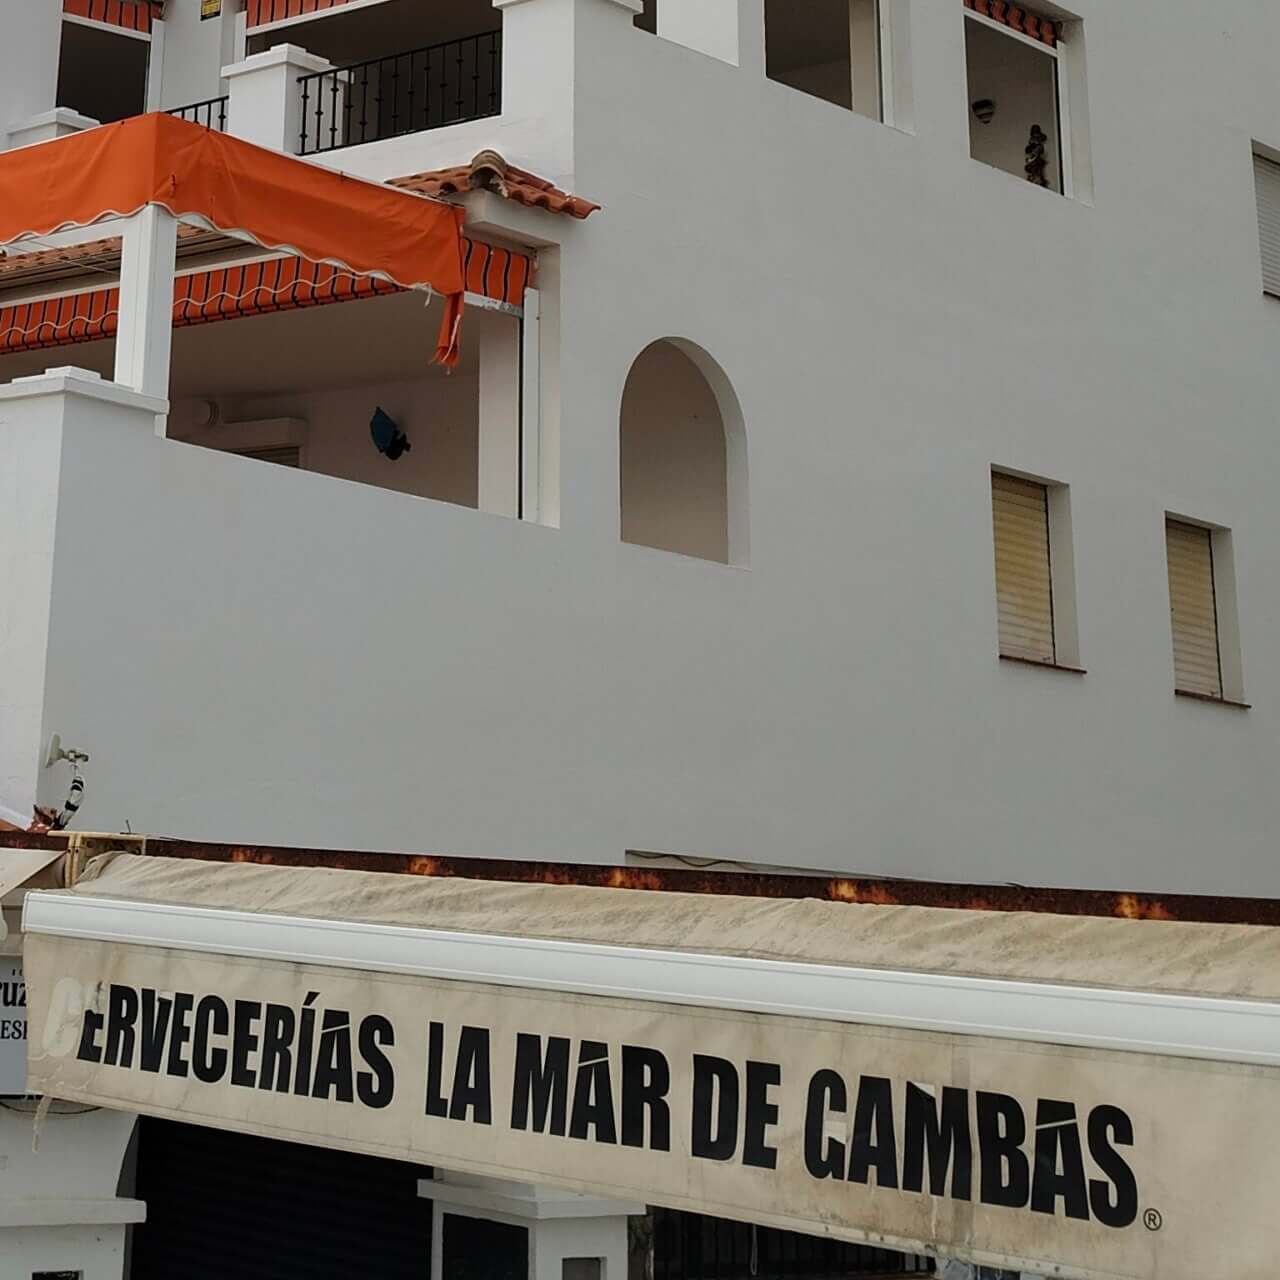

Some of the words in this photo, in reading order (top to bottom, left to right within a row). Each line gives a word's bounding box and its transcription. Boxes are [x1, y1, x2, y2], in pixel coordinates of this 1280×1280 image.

[426, 1021, 492, 1126] LA
[691, 1053, 781, 1170] DE
[804, 1068, 1138, 1229] GAMBAS
